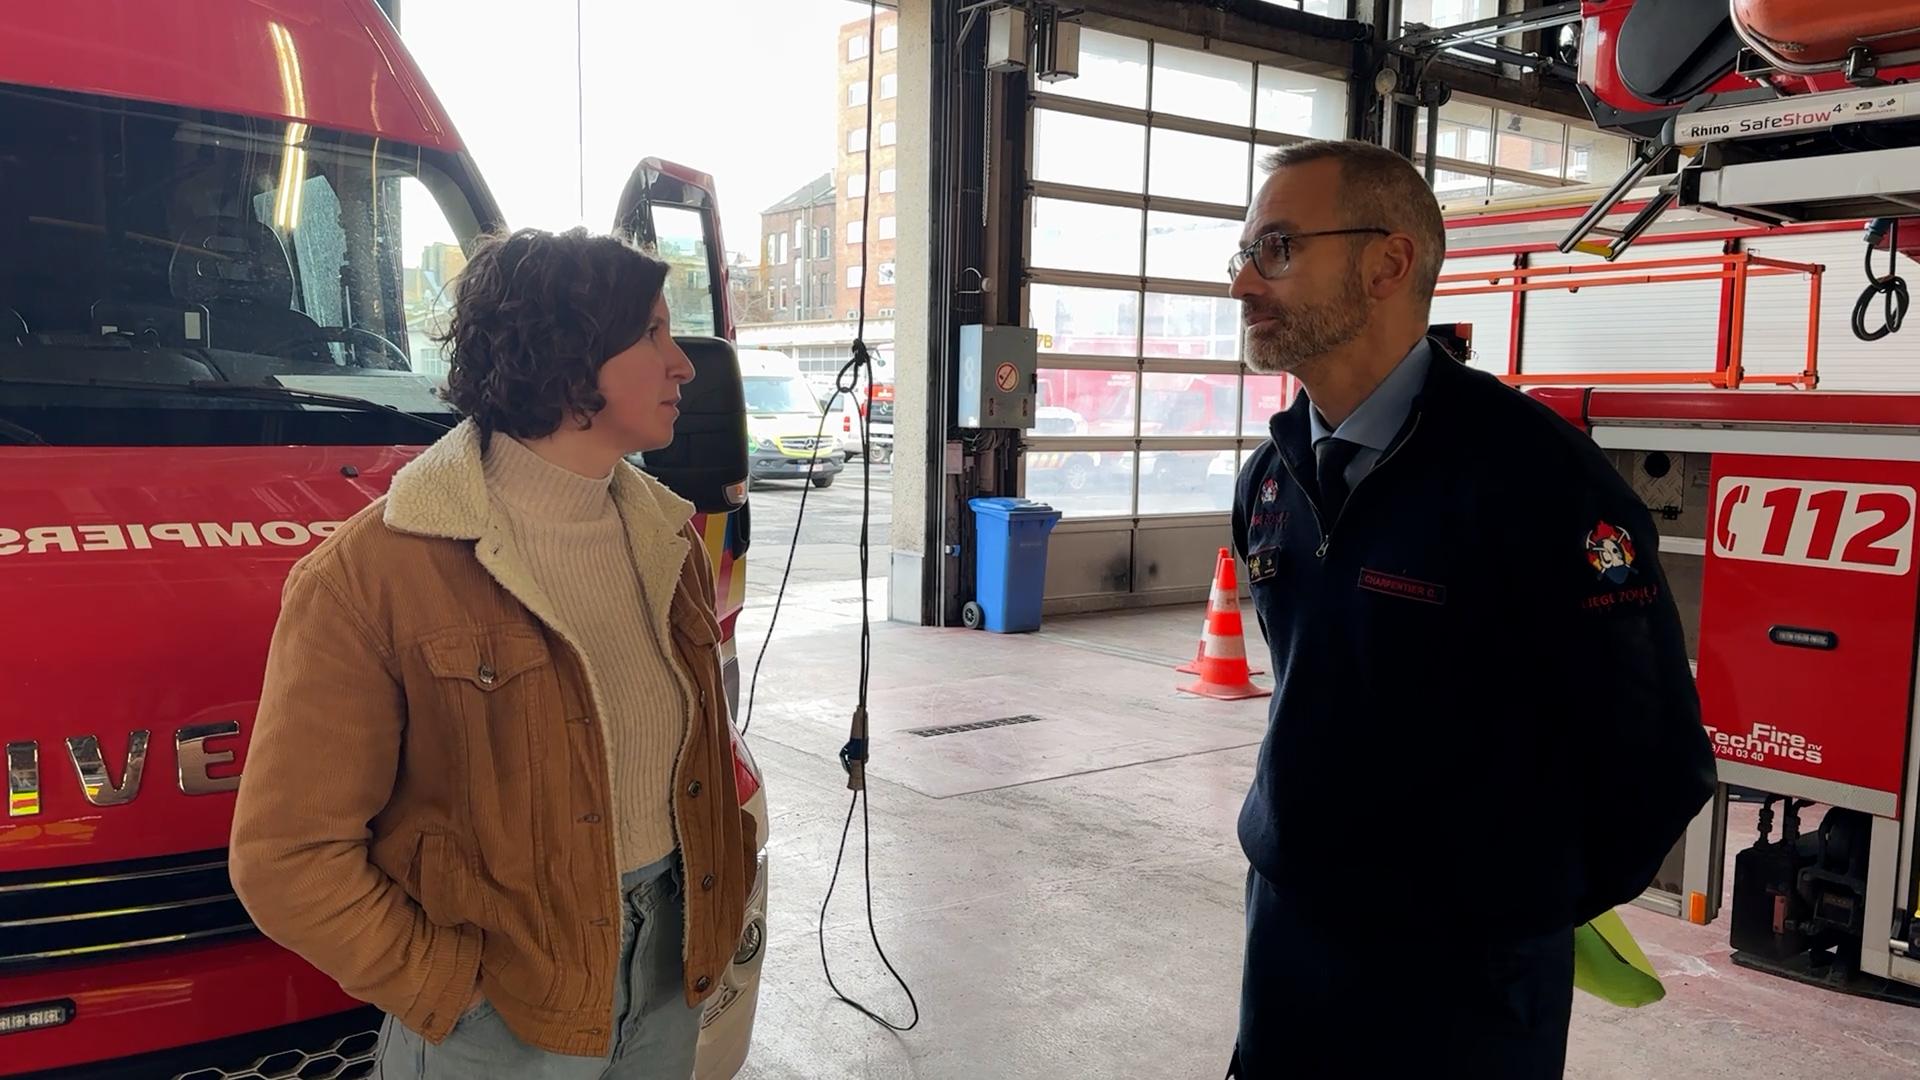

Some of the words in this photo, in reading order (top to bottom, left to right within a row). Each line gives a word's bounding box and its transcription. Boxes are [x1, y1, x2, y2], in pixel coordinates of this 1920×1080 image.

[1691, 124, 1730, 138] Rhino
[1761, 486, 1911, 566] 112
[1702, 724, 1822, 764] Technics
[1752, 722, 1805, 747] Fire
[1750, 751, 1764, 762] 40
